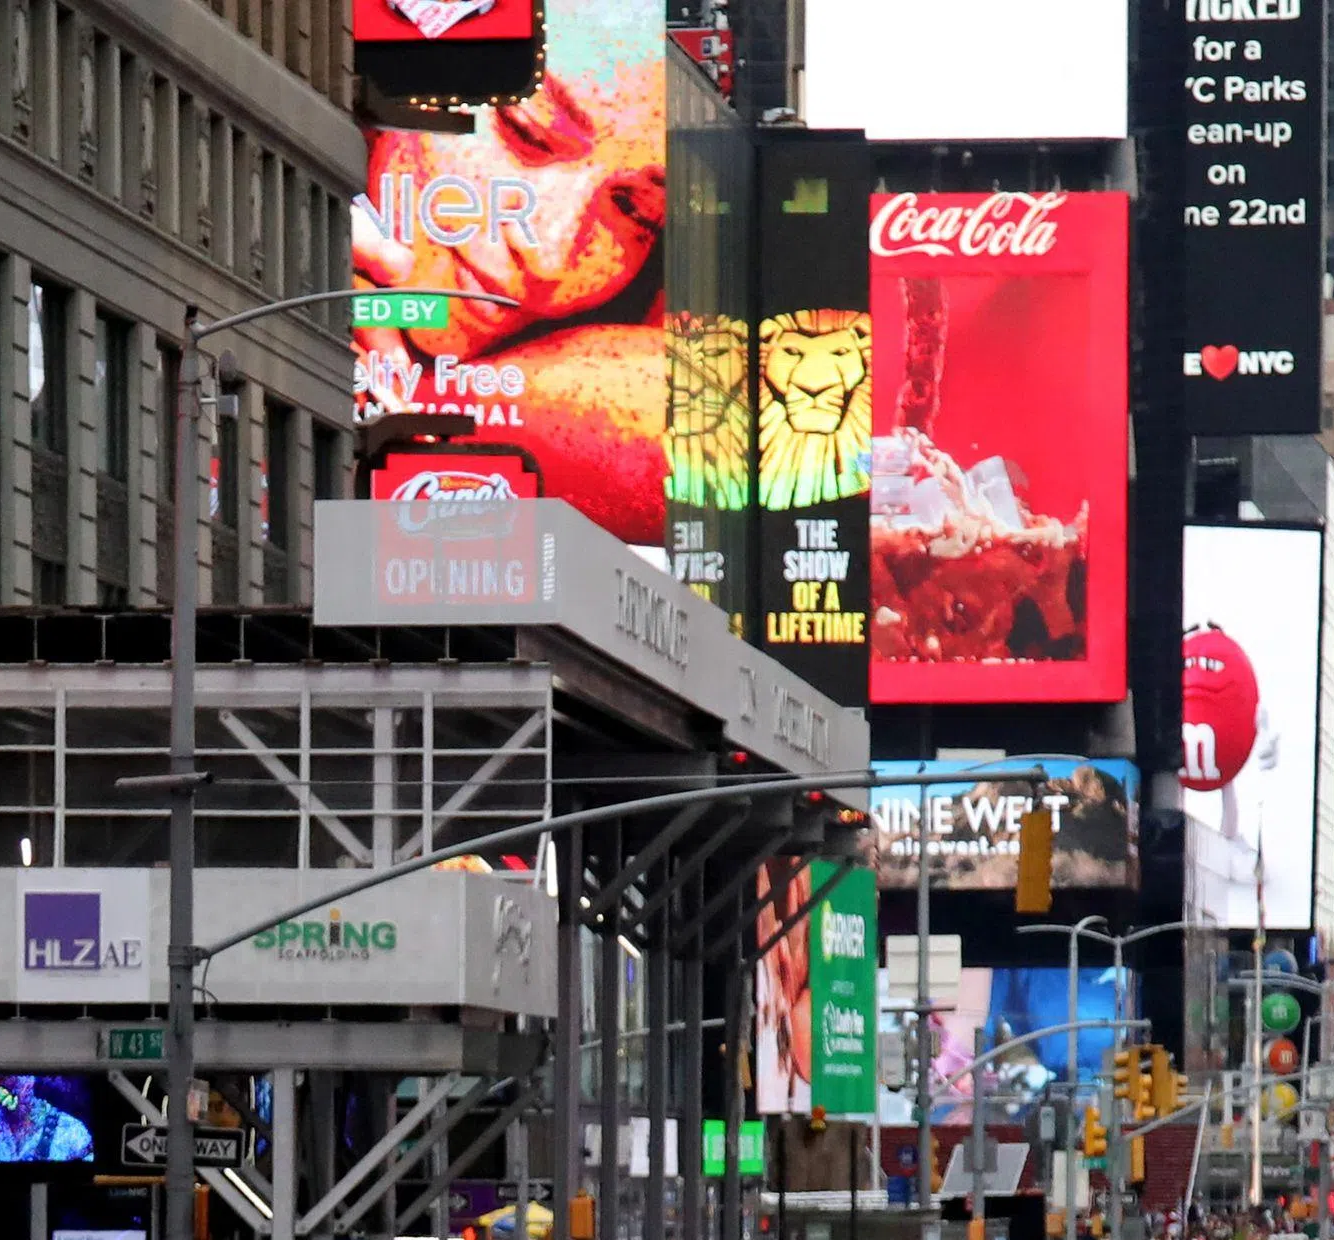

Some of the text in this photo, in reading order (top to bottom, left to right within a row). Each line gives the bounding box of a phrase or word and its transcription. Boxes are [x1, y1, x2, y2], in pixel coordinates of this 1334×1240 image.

[1193, 36, 1262, 61] for a
[1224, 75, 1306, 102] Parks
[1207, 164, 1246, 185] on
[1228, 199, 1306, 225] 22nd
[402, 299, 437, 320] BY
[435, 355, 525, 396] Free
[1238, 351, 1295, 375] NYC
[795, 519, 838, 550] THE
[783, 550, 850, 582] SHOW
[793, 582, 840, 611] OF A
[767, 612, 865, 643] LIFETIME
[962, 796, 1069, 834] WET
[129, 1032, 144, 1056] 43
